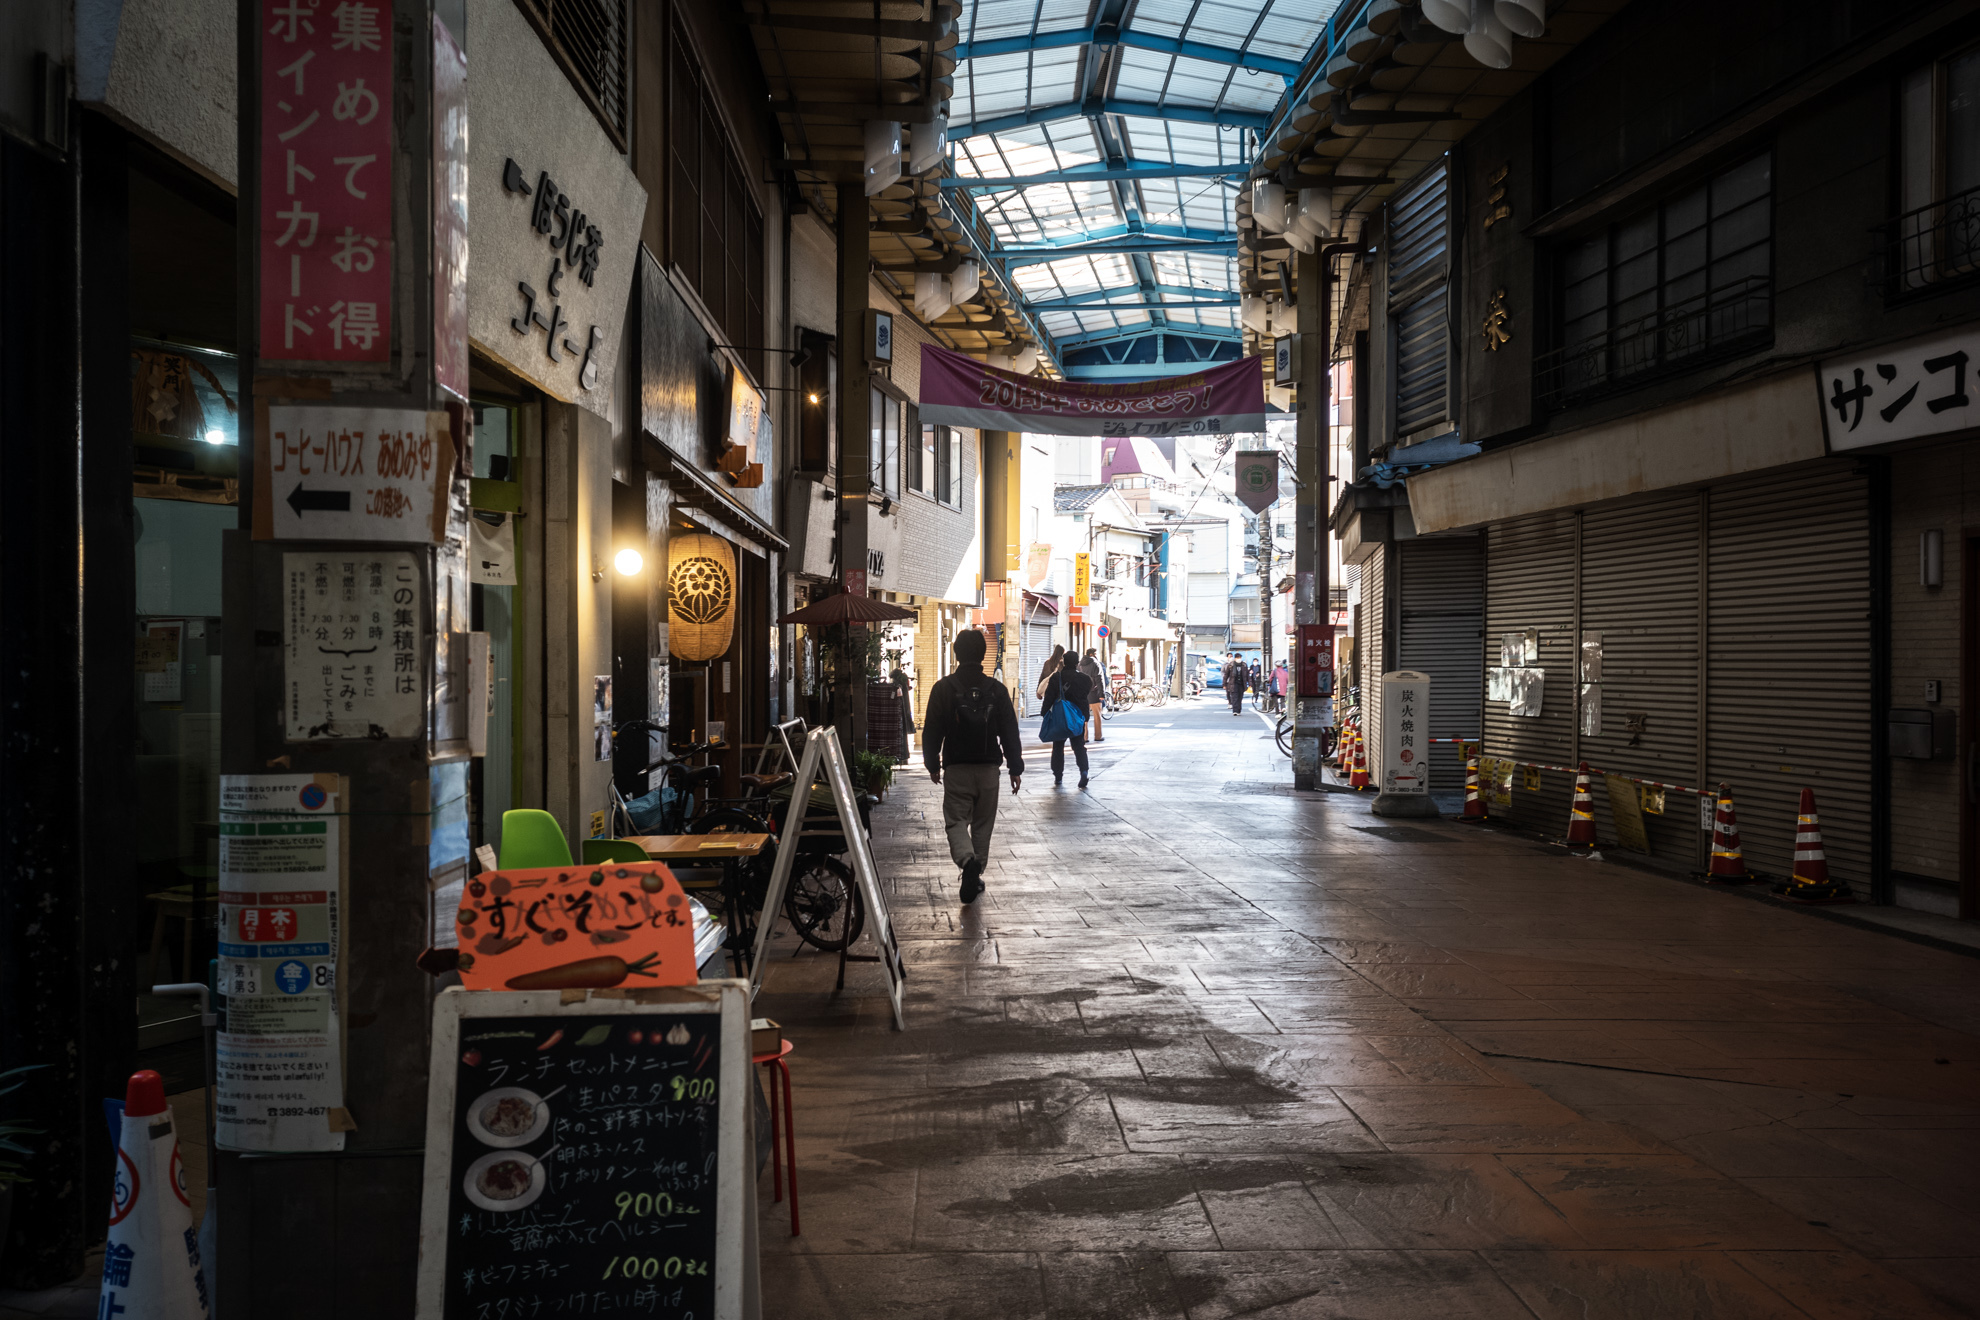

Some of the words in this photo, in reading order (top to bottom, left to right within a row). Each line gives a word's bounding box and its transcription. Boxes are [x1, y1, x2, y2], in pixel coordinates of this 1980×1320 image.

[268, 0, 321, 349] ポイントカード
[328, 1, 382, 350] 集めてお得
[532, 171, 603, 288] ほうじ茶
[550, 258, 564, 297] と
[512, 281, 582, 363] コーヒー
[979, 378, 1072, 413] 20周年
[1831, 350, 1980, 433] サンコ
[274, 428, 364, 476] コーヒーハウス
[377, 428, 432, 481] あめみや
[315, 627, 328, 640] 分
[342, 627, 356, 640] 分
[393, 566, 416, 694] この集積所は
[340, 665, 357, 711] ごみを
[363, 665, 375, 698] までに
[1400, 689, 1415, 747] 炭火焼肉
[243, 909, 260, 926] 月
[270, 909, 291, 926] 木
[282, 962, 303, 979] 金
[315, 965, 327, 986] 8
[579, 1083, 664, 1107] 生パスタ
